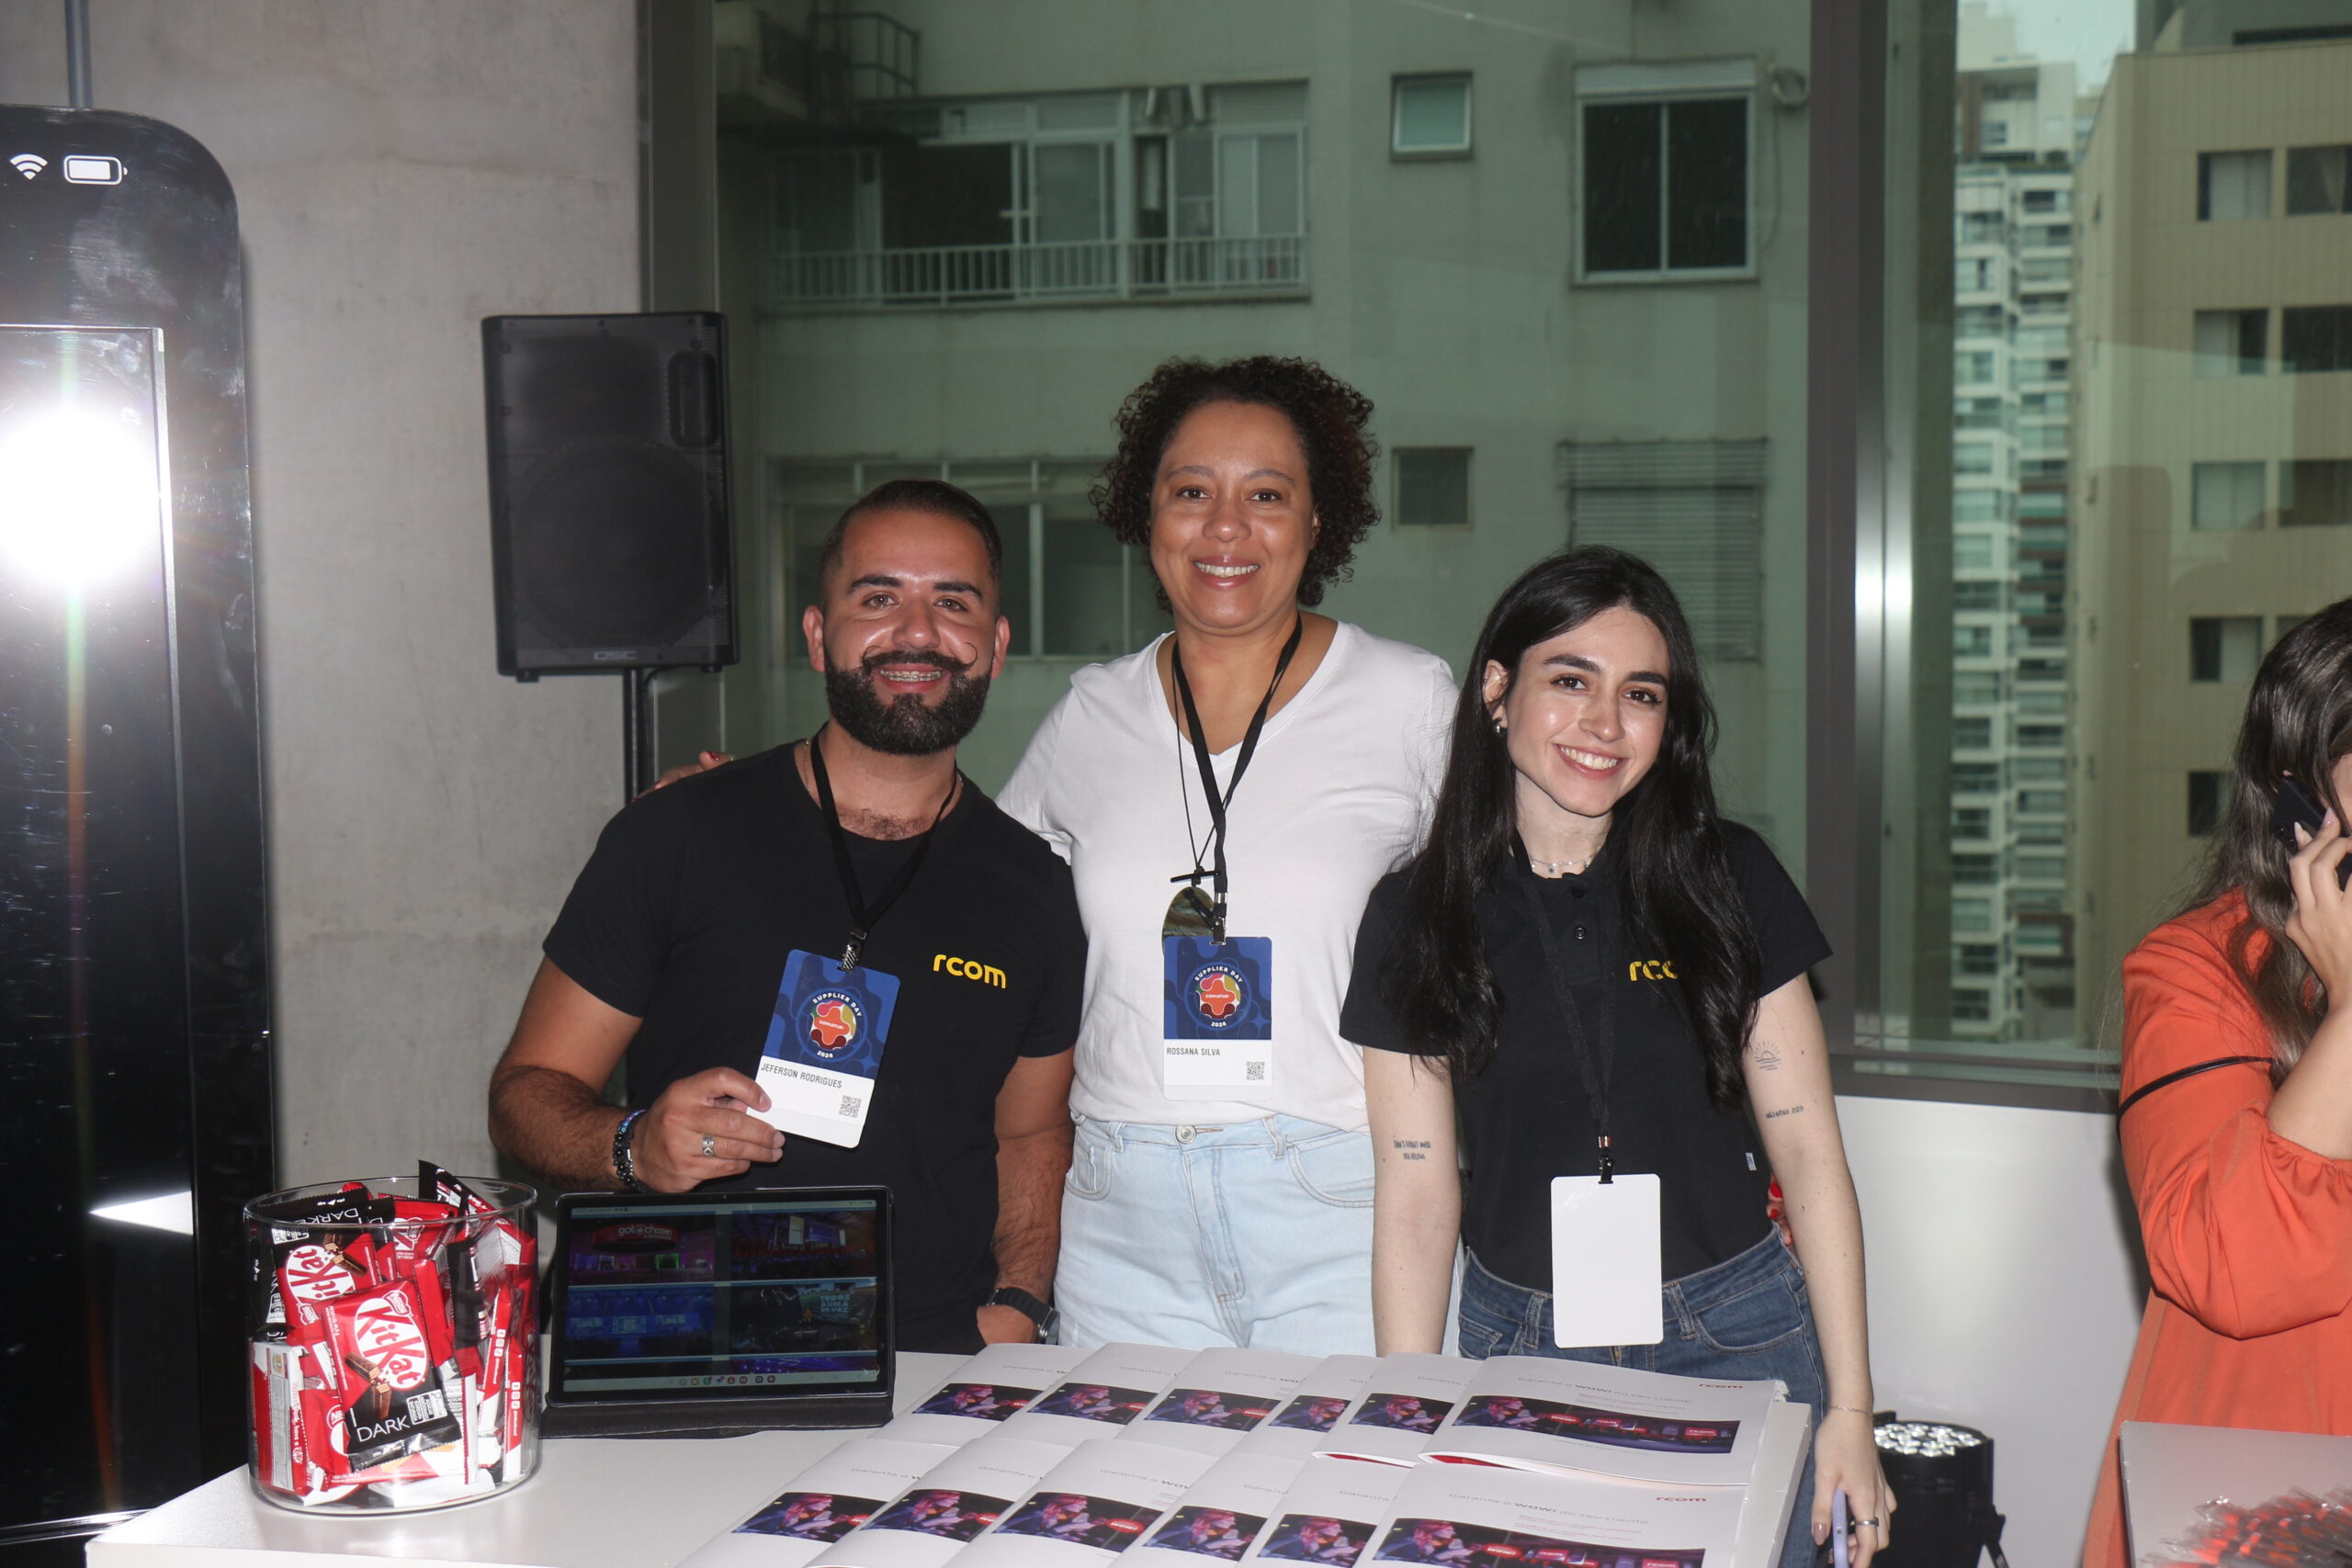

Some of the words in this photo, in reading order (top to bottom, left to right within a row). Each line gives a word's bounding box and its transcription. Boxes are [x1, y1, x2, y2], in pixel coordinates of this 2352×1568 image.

[933, 953, 1007, 989] rcom
[1194, 965, 1228, 982] SUPPLIER
[1230, 970, 1243, 983] DAY
[1629, 960, 1679, 981] rco
[812, 992, 850, 1004] SUPPLIER
[851, 1002, 862, 1017] DAY
[817, 1050, 833, 1058] 2024
[1166, 1047, 1199, 1055] ROSSANA
[1200, 1048, 1220, 1056] SILVA
[761, 1063, 798, 1078] JEFERSON
[799, 1072, 842, 1089] RODRIGUES
[355, 1309, 427, 1387] KitKat
[356, 1415, 412, 1443] DARK
